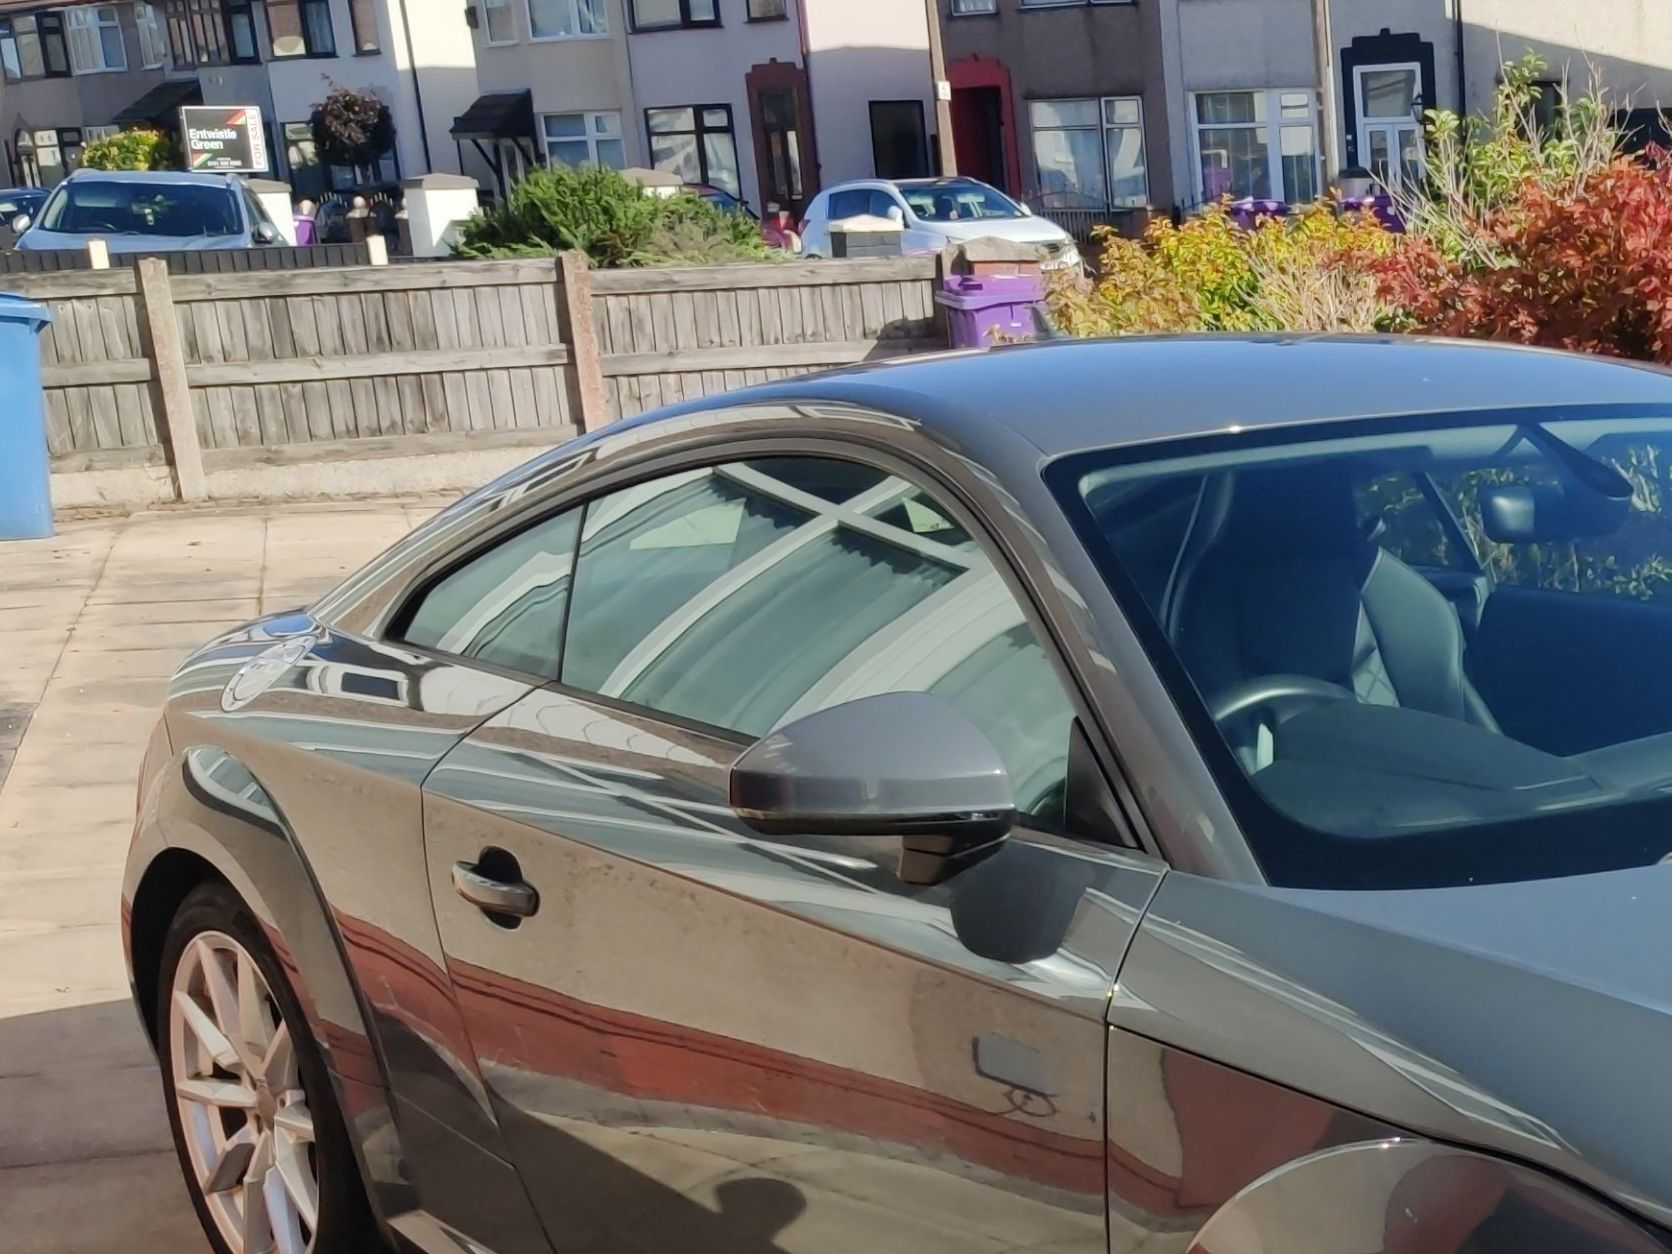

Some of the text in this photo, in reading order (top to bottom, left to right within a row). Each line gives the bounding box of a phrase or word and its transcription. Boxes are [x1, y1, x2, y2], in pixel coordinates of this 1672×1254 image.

[188, 128, 238, 140] Entwistle
[248, 113, 263, 166] FOR SALE
[190, 140, 225, 150] Green
